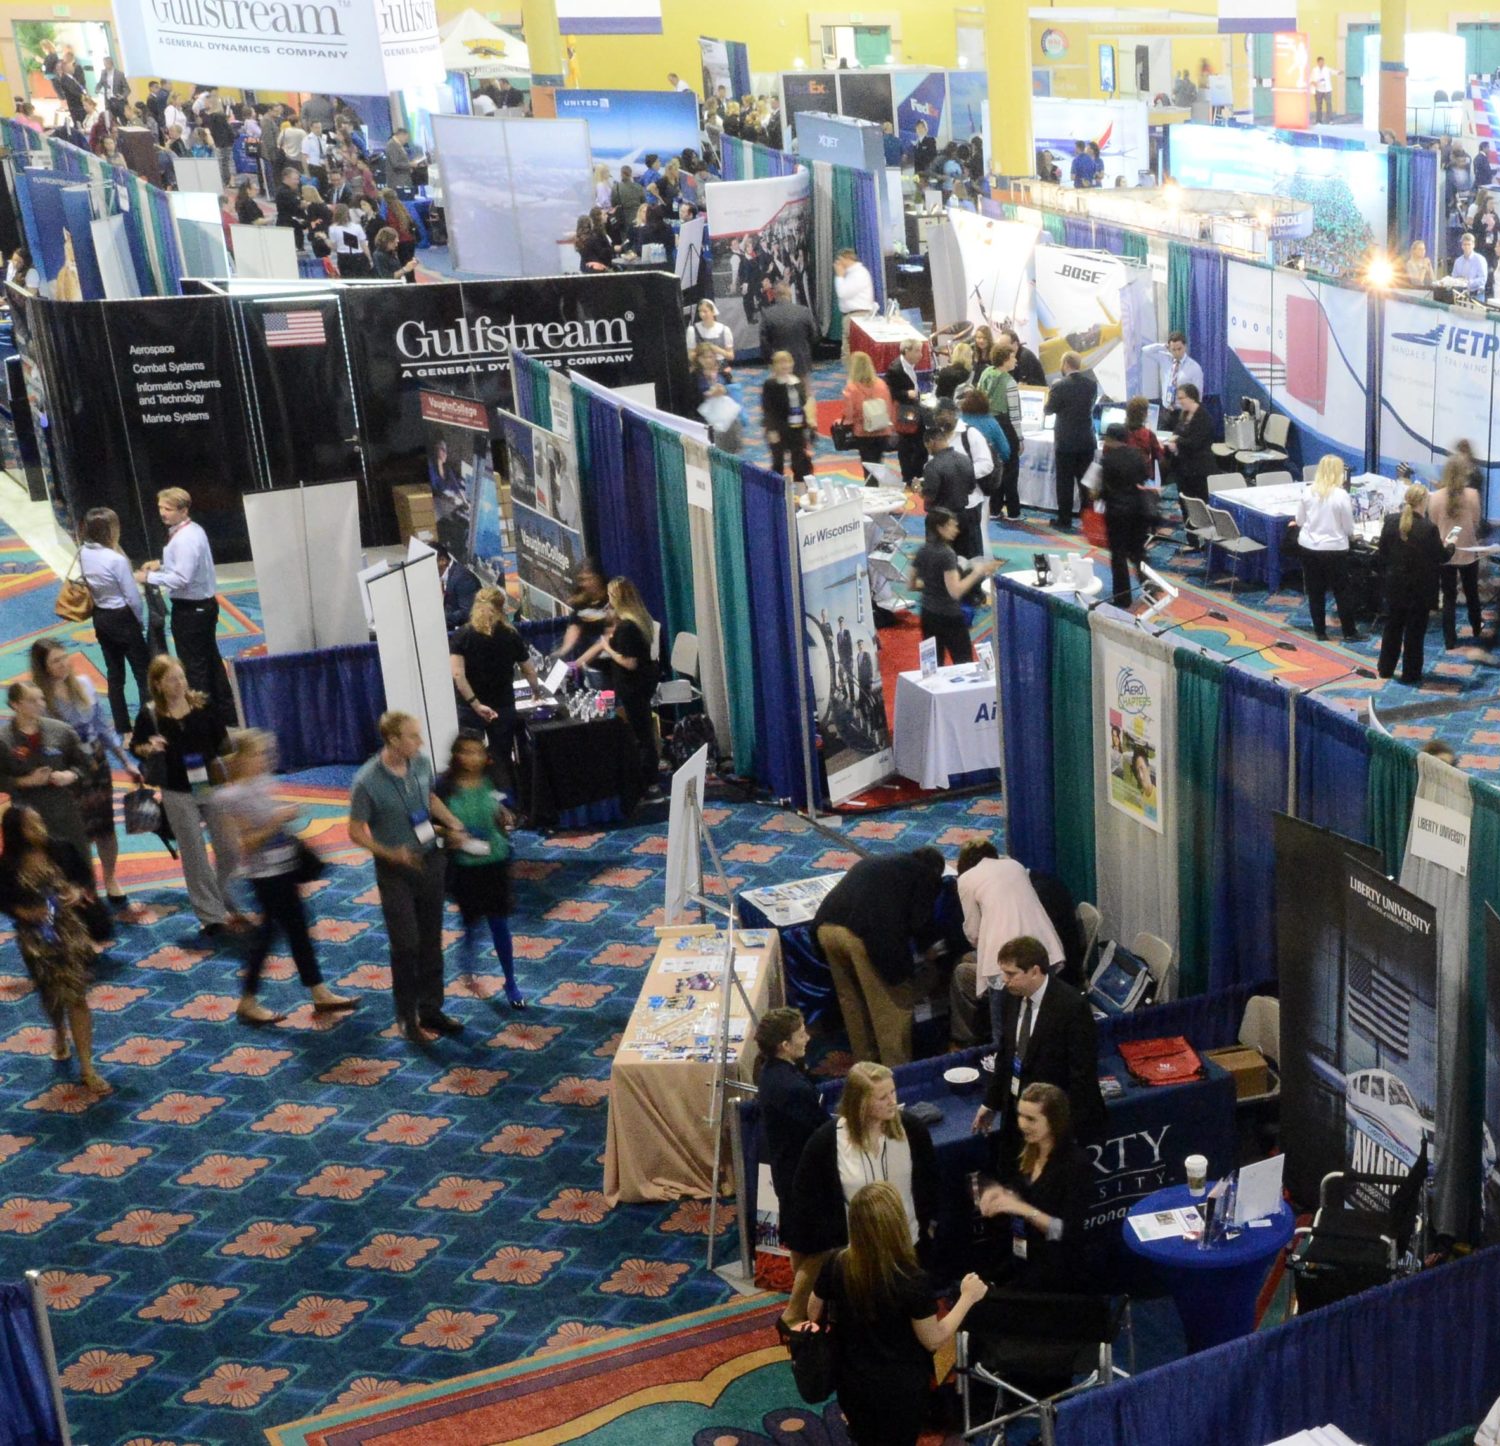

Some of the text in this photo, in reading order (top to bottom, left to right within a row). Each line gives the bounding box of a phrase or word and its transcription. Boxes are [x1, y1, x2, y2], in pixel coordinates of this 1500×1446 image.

[165, 37, 205, 50] GENERAL
[207, 42, 270, 55] DYNAMICS
[276, 47, 349, 60] COMPANY
[563, 99, 599, 108] UNITED
[1062, 264, 1102, 285] BOSE
[396, 314, 633, 360] Gulfstream
[129, 344, 175, 356] Aerospace
[133, 361, 205, 374] Combat Systems
[402, 369, 413, 379] A
[416, 363, 484, 378] GENERAL
[567, 353, 634, 367] COMPANY
[136, 378, 222, 393] Information Systems
[139, 393, 205, 406] and Technology
[142, 411, 210, 425] Marine Systems
[816, 518, 862, 544] Wisconsin
[1417, 816, 1467, 848] LIBERTY UNIVERSITY
[1350, 876, 1431, 935] LIBERTY UNIVERSITY
